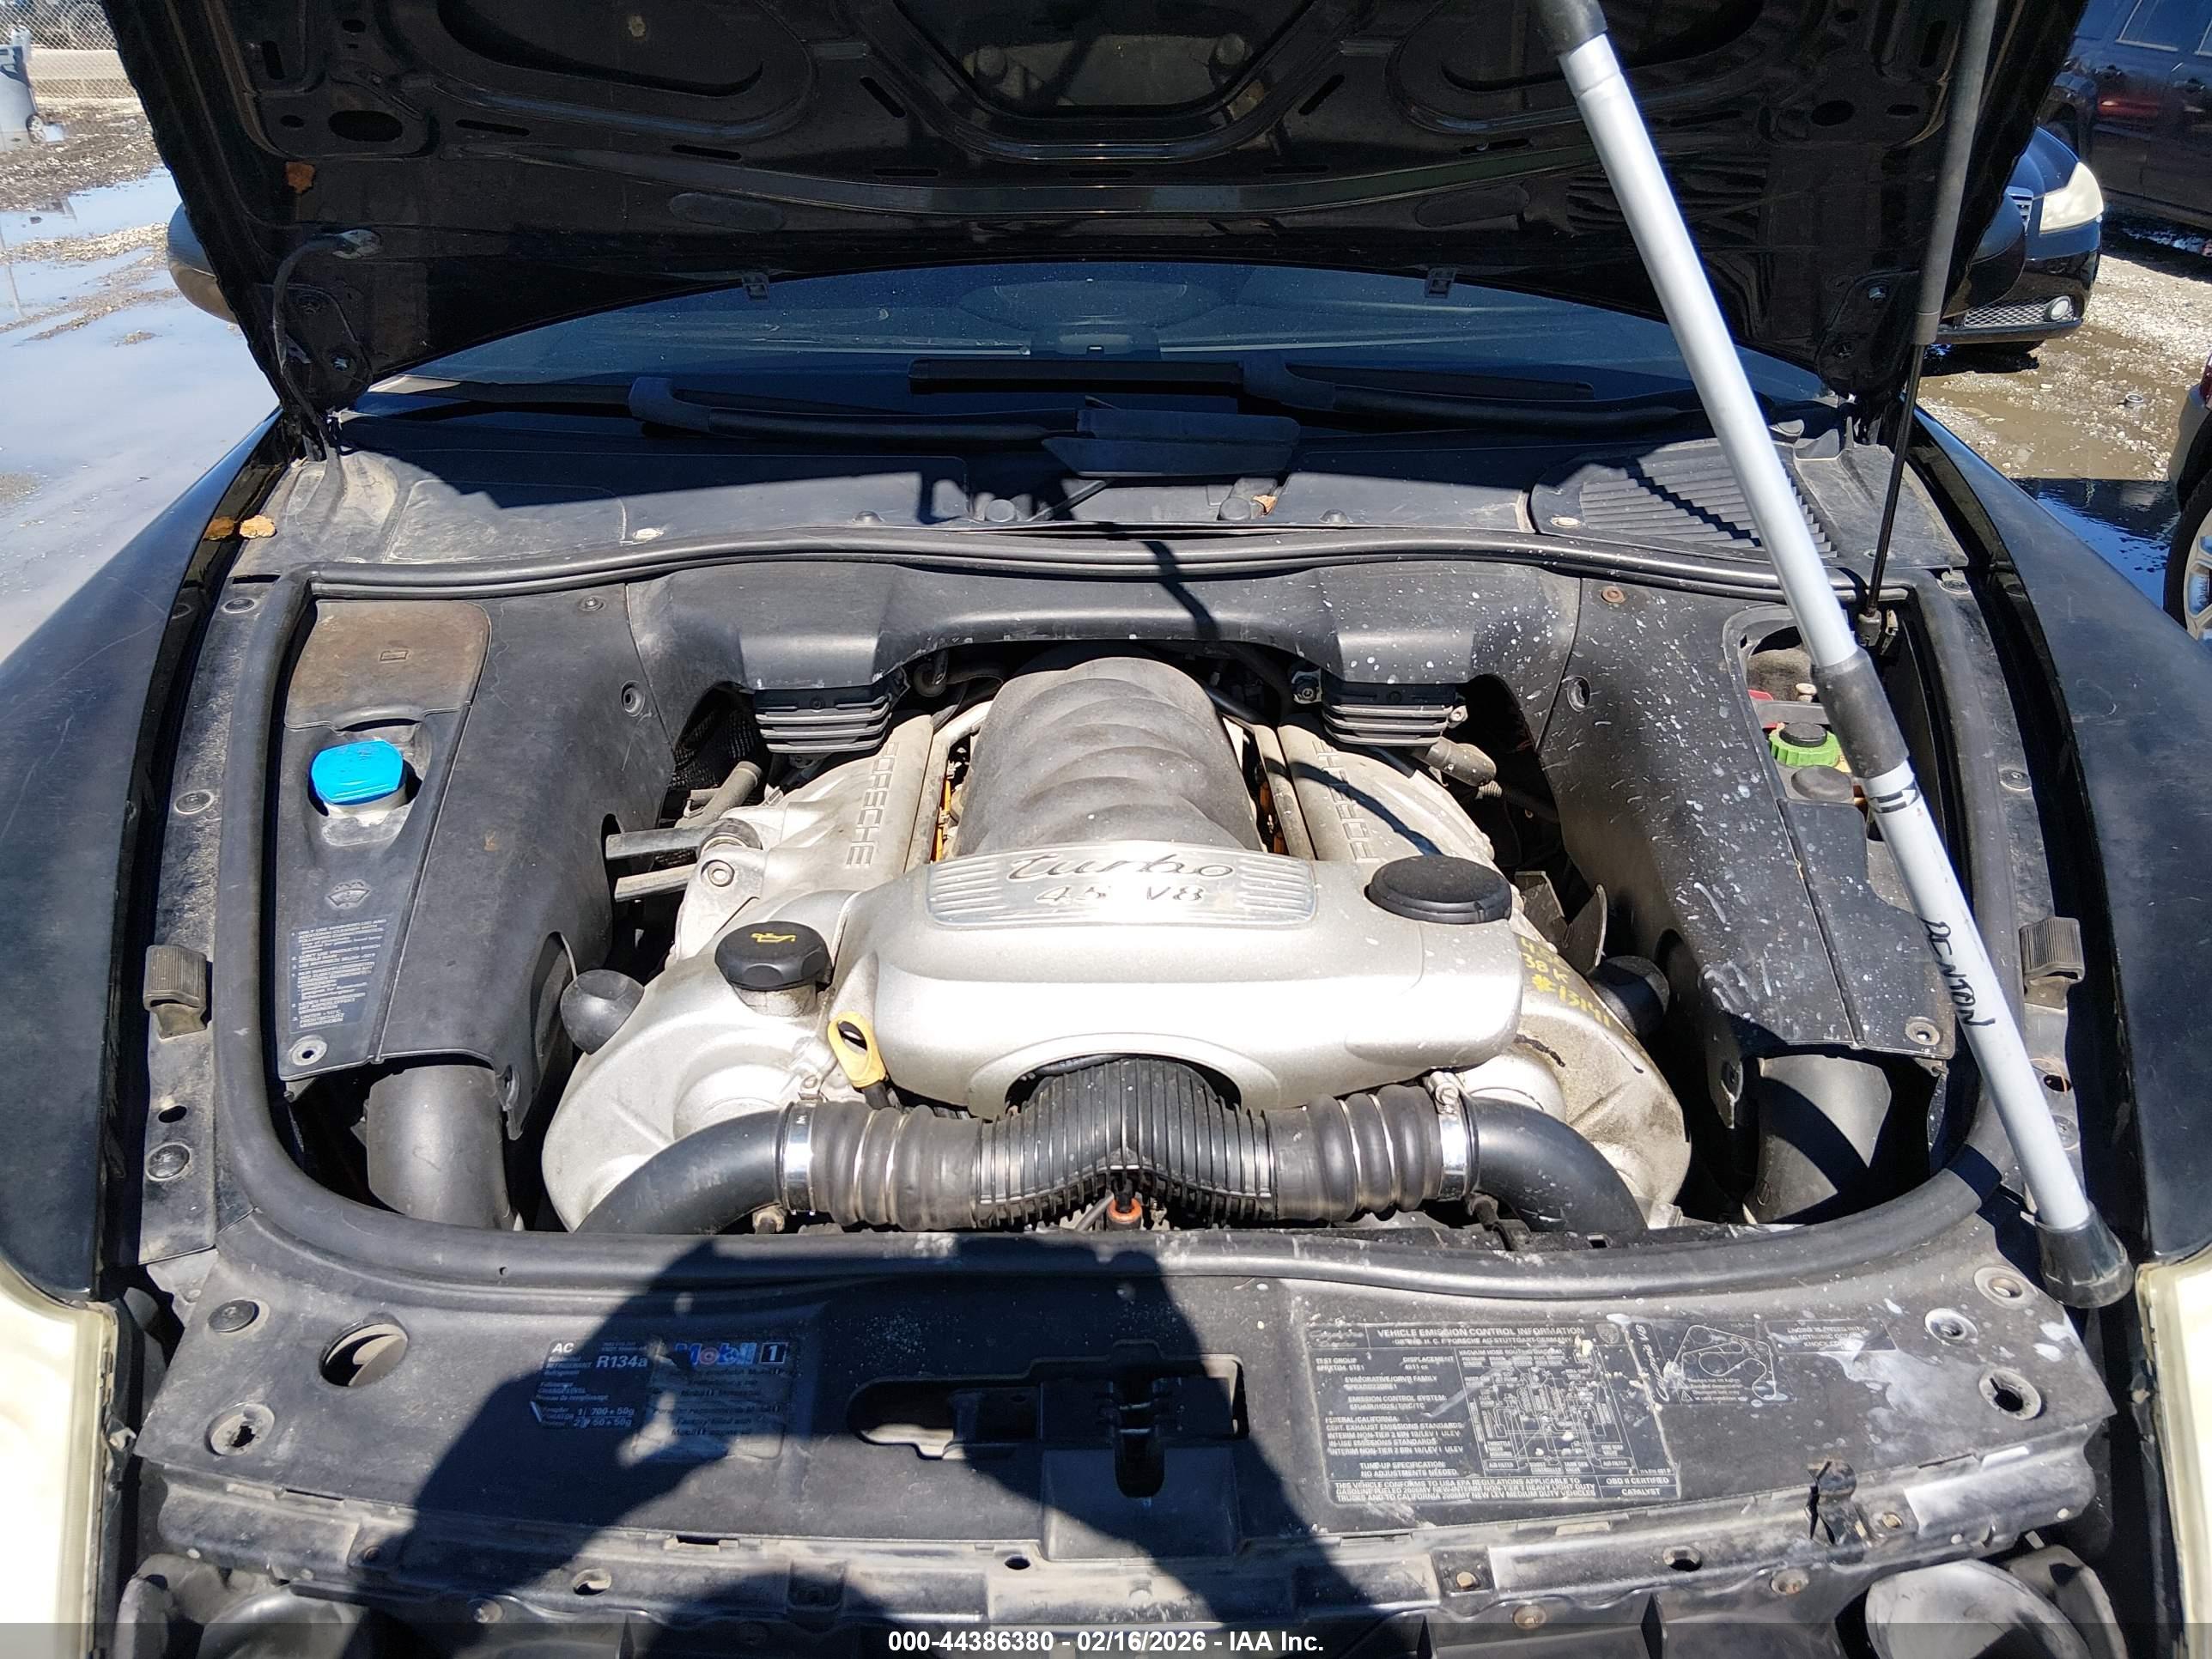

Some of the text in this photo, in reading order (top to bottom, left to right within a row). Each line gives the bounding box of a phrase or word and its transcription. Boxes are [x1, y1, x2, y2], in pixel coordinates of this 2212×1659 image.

[845, 742, 900, 867] PORSCHE
[1006, 854, 1234, 881] turbo
[1146, 885, 1204, 901] V8
[1376, 1327, 1585, 1338] VEHICLE EMISSION CONTROL INFORMATION
[551, 1342, 574, 1353] AC
[596, 1355, 648, 1368] R134a
[1384, 1480, 1426, 1489] CONFORMS
